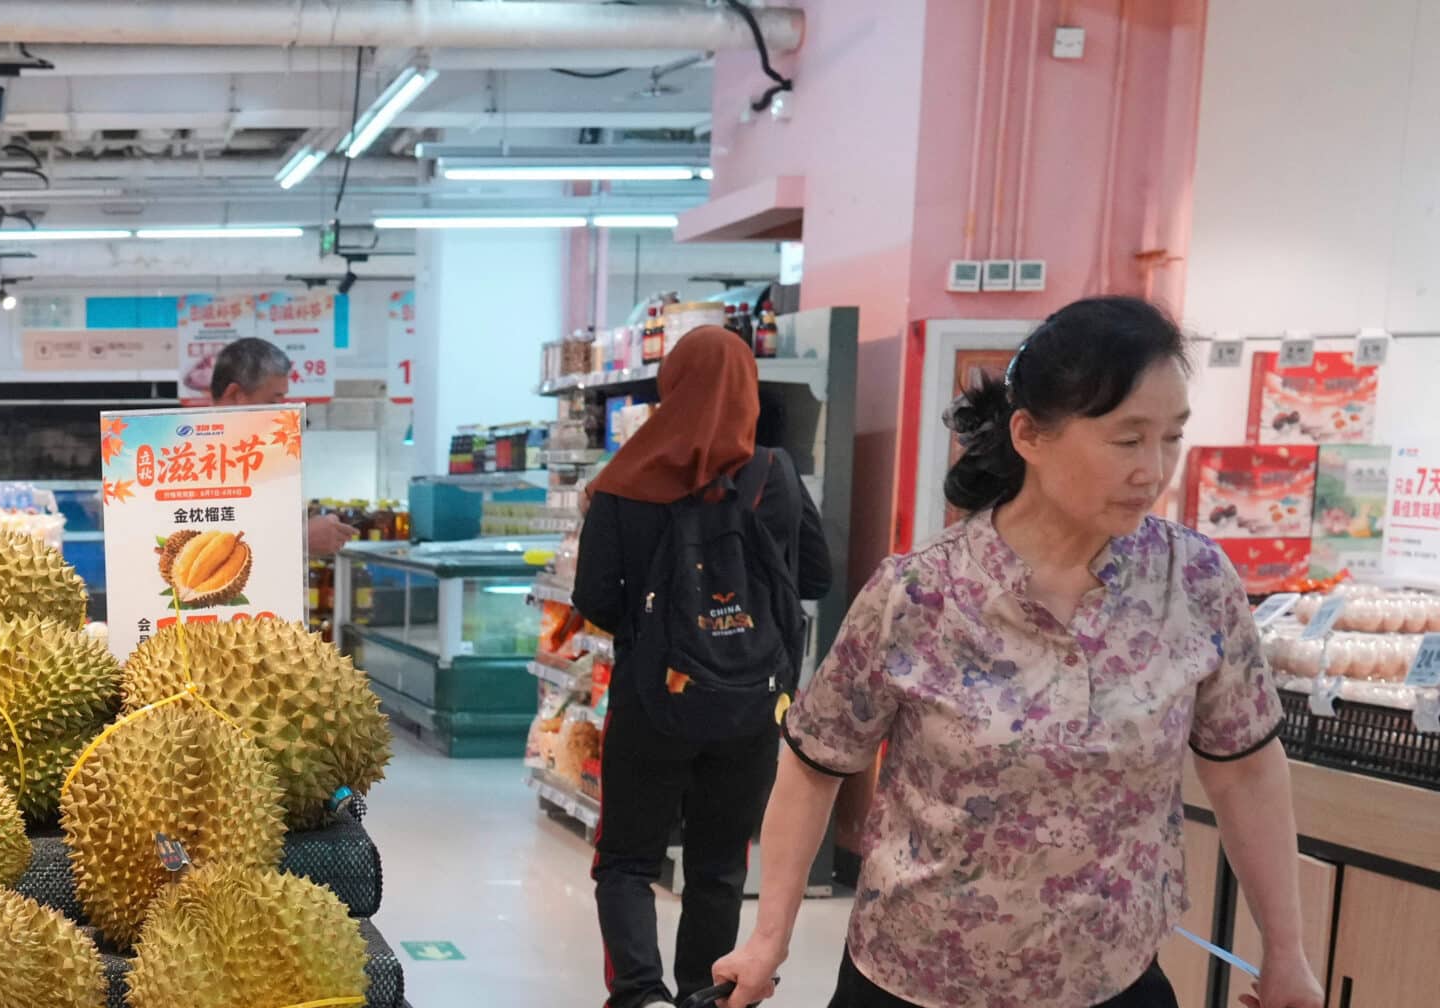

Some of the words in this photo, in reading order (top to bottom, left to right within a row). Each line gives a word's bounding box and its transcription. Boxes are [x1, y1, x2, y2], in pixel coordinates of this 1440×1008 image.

[157, 434, 267, 485] 滋补节
[173, 506, 236, 524] 金枕榴莲
[710, 604, 742, 617] CHINA
